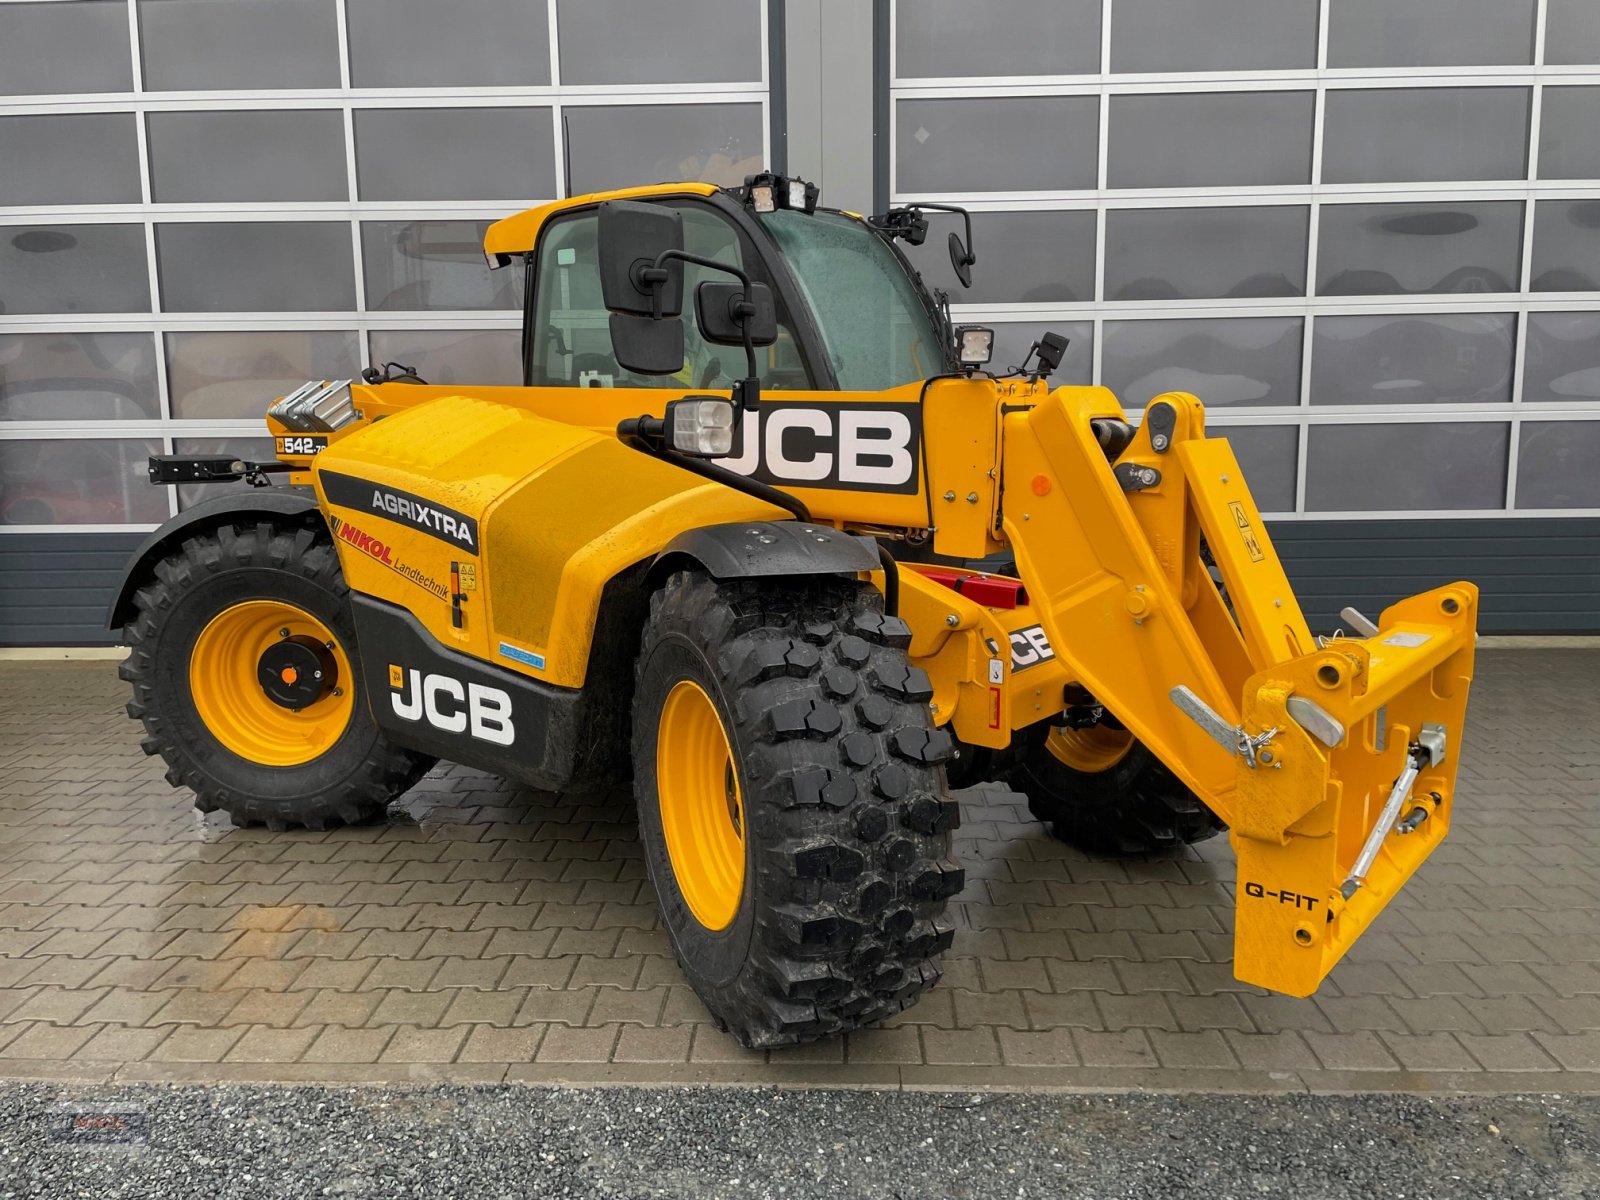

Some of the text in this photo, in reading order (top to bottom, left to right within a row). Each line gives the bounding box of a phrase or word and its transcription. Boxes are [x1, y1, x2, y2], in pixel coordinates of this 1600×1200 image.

[711, 408, 913, 485] JCB
[372, 490, 474, 546] AGRIXTRA
[340, 522, 450, 599] NIKOL Landtechnik
[1009, 626, 1055, 669] CB
[391, 668, 515, 746] JCB
[1245, 881, 1319, 911] Q-FIT
